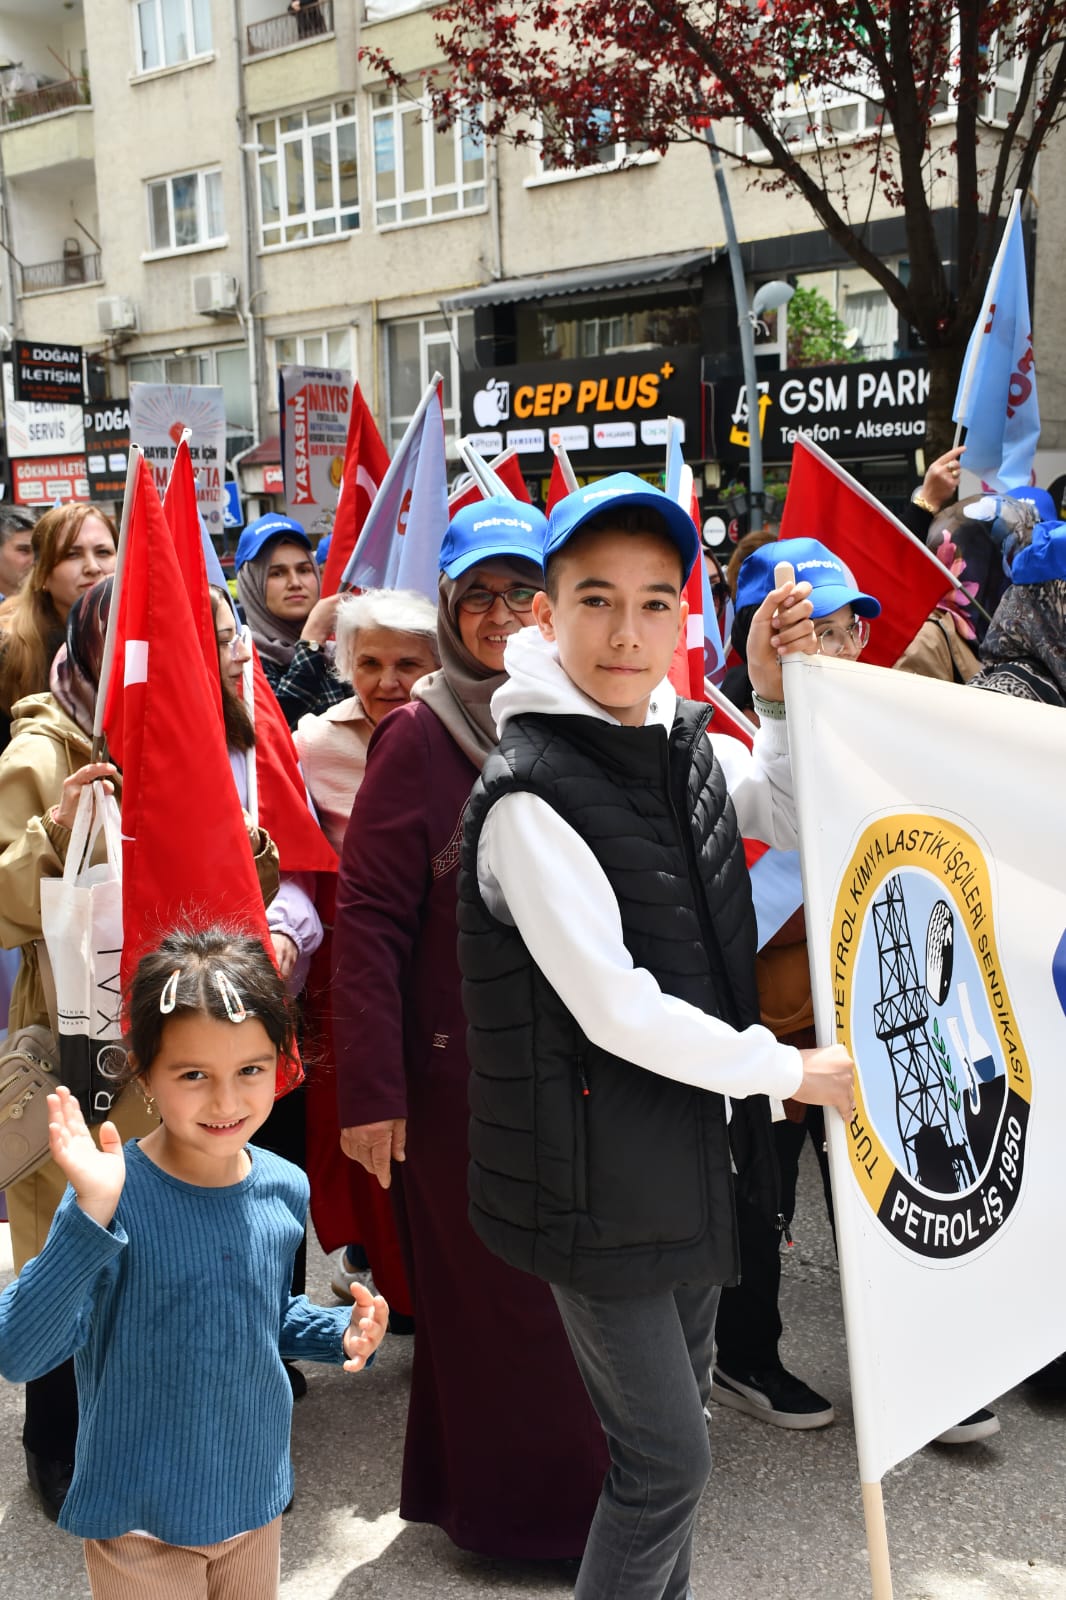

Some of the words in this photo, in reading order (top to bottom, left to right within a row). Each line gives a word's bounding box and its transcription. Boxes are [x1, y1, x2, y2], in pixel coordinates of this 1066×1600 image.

[33, 347, 79, 363] DOĞAN
[21, 366, 81, 385] İLETİŞİM
[308, 384, 348, 414] MAYIS
[513, 382, 573, 419] CEP
[779, 375, 847, 416] GSM
[858, 368, 929, 409] PARK
[29, 419, 65, 440] SERVİS
[95, 407, 130, 432] DOĞA
[855, 420, 926, 438] Aksesua
[144, 446, 168, 459] HAYIR
[293, 395, 310, 503] YAŞASIN
[17, 463, 58, 479] GÖKHAN
[835, 909, 856, 1029] PETROL
[850, 839, 884, 904] KİMYA
[886, 829, 949, 860] LASTİK
[943, 842, 986, 930] İŞÇİLERİ
[977, 933, 1025, 1084] SENDİKASI
[890, 1186, 1004, 1247] PETROL-İŞ
[999, 1116, 1022, 1191] 1950
